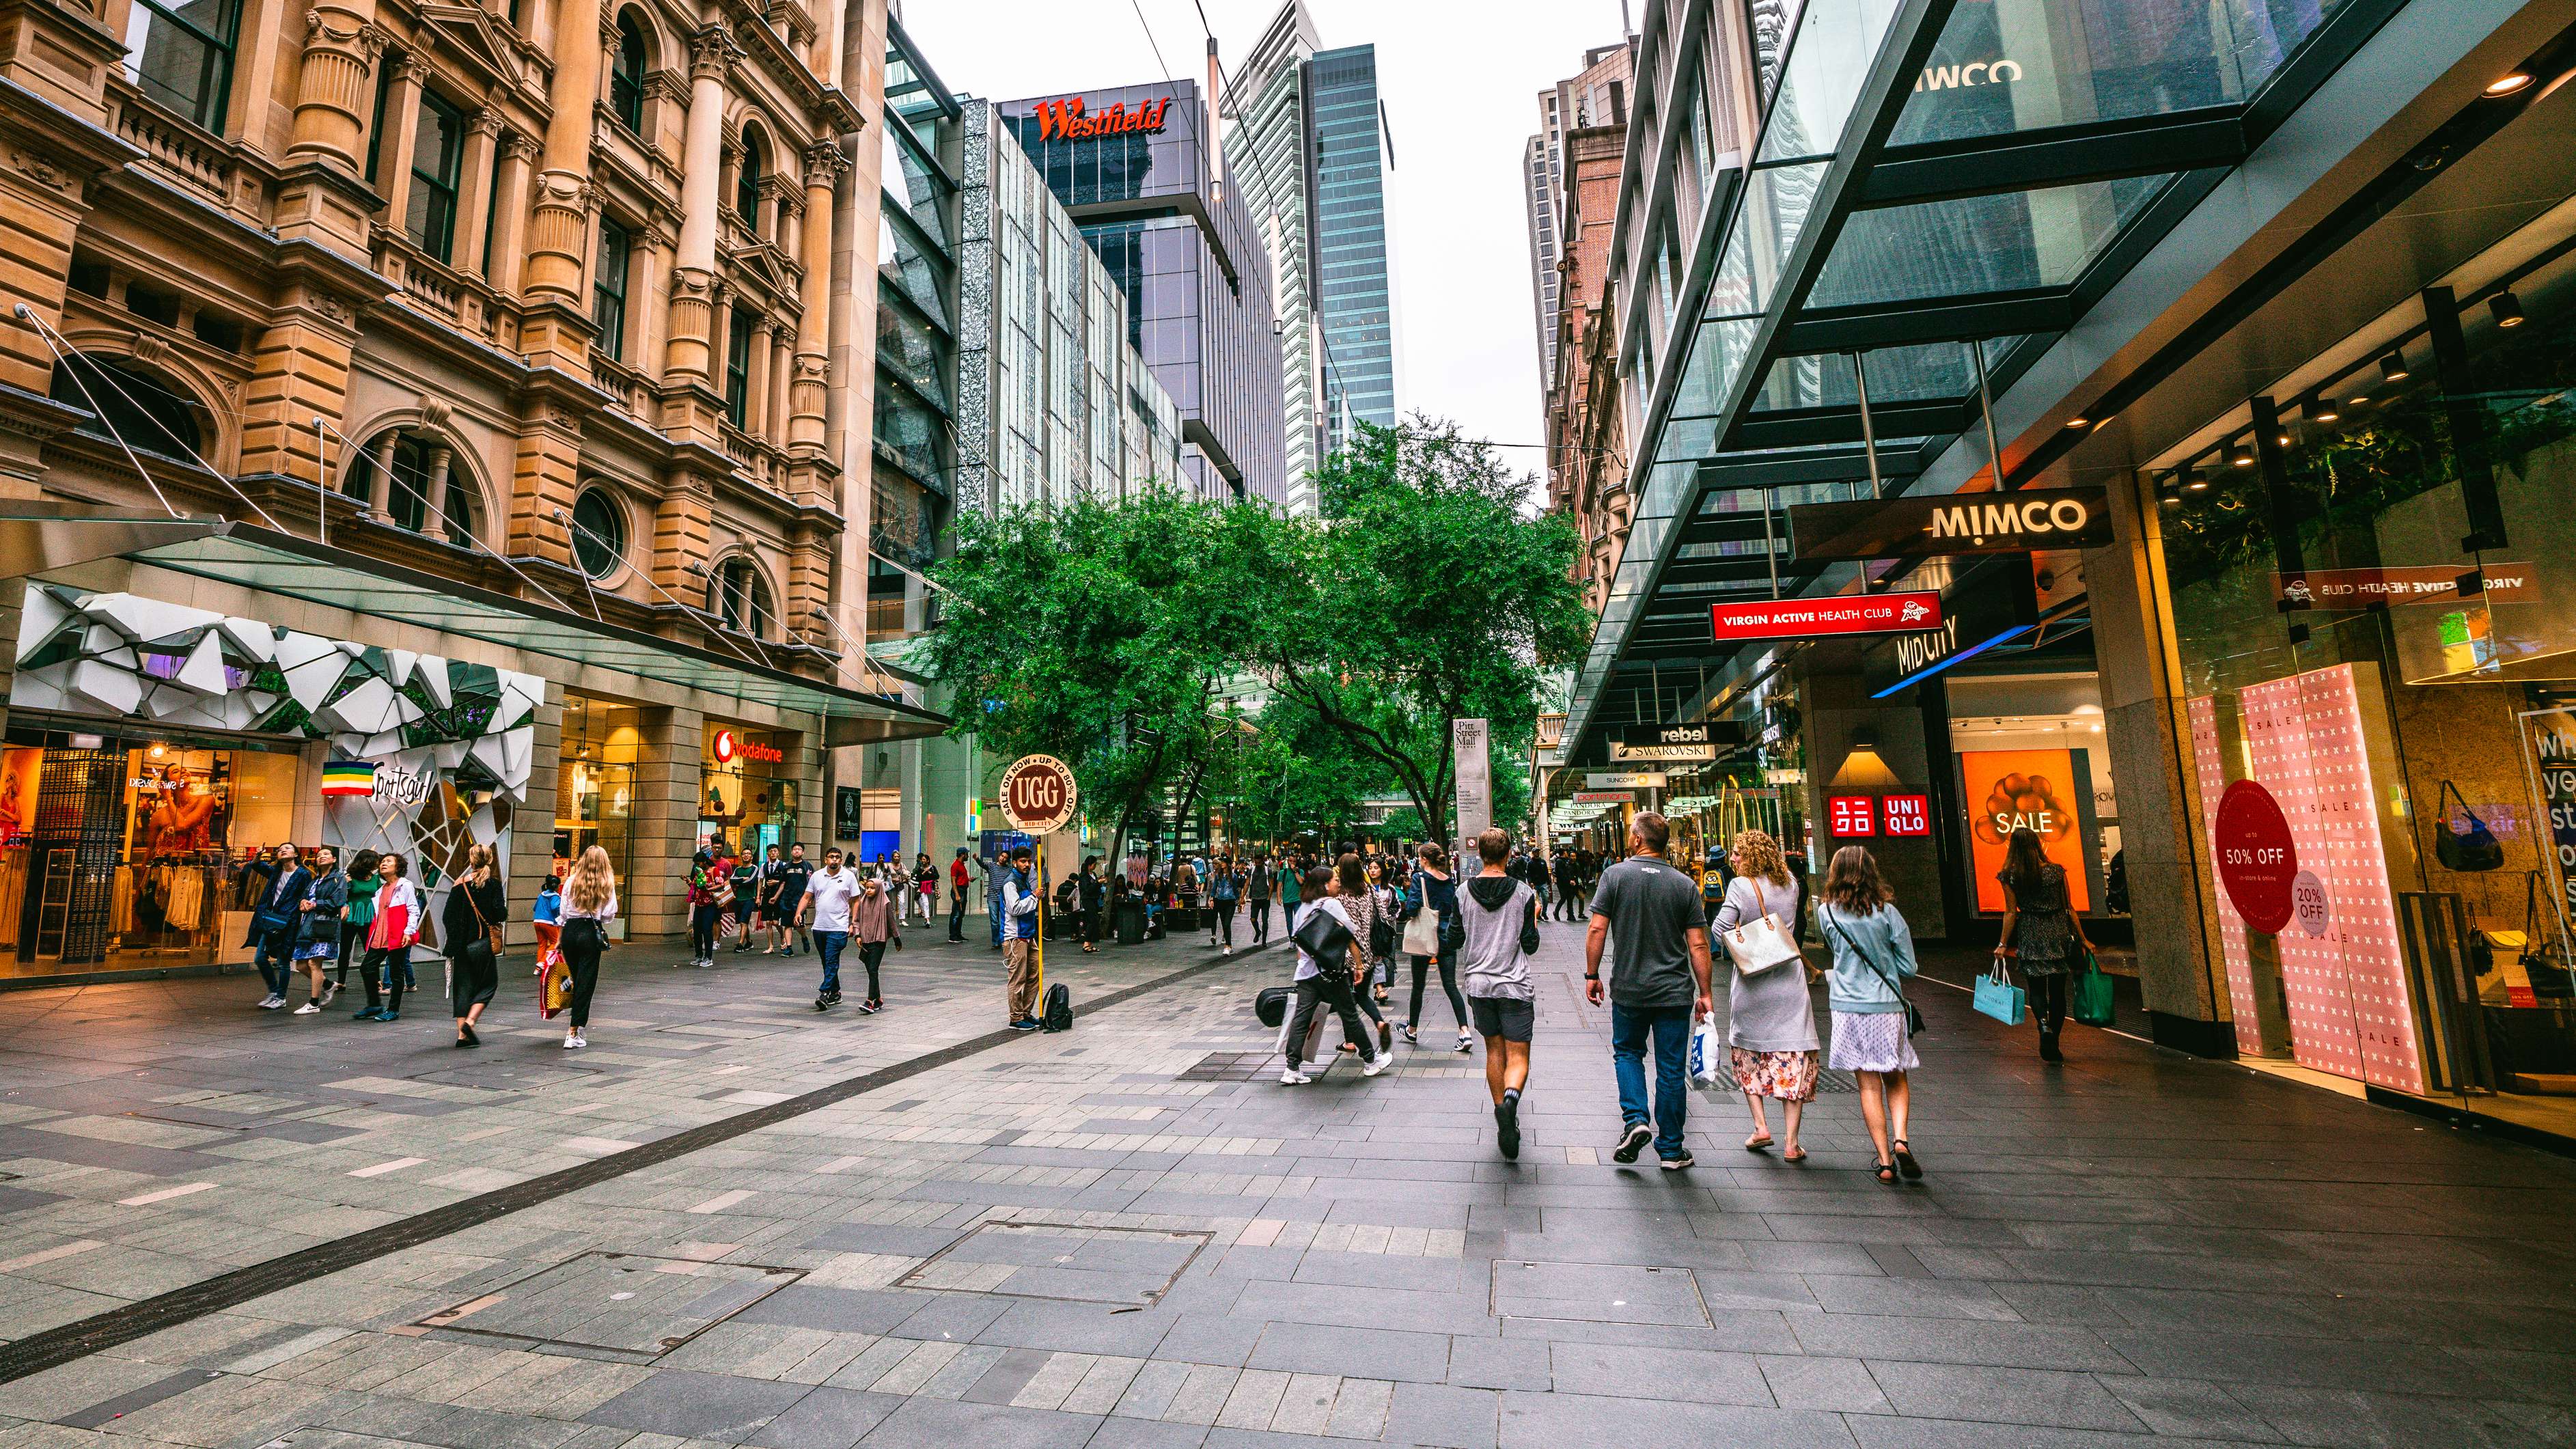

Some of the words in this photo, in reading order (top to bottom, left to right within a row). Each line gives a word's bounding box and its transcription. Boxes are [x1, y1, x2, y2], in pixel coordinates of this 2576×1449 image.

[1032, 96, 1171, 142] Westfield
[1932, 499, 2087, 545] MIMCO
[1723, 615, 1768, 626] VIRGIN
[1773, 612, 1814, 624] ACTIVE
[1818, 609, 1860, 621] HEALTH
[1864, 607, 1892, 618] CLUB
[1458, 721, 1474, 730] Pitt
[2257, 716, 2291, 730] SALE
[1456, 728, 1481, 736] Street
[1456, 736, 1476, 745] Mall
[1661, 726, 1708, 743] rebel
[734, 741, 782, 763] vodafone
[1635, 745, 1706, 756] SWAROVSKI
[1011, 758, 1030, 773] NOW
[1054, 762, 1064, 773] TO
[76, 761, 84, 791] CELEBRATE
[1003, 774, 1013, 788] ON
[1064, 774, 1075, 795] 80%
[1016, 775, 1059, 809] UGG
[1001, 791, 1012, 815] SALE
[1064, 797, 1074, 816] OFF
[1887, 800, 1920, 814] UNI
[2311, 801, 2350, 814] SALE
[1889, 816, 1924, 833] QLO
[1996, 812, 2053, 833] SALE
[2226, 848, 2252, 865] 50%
[2258, 848, 2284, 864] OFF
[2297, 888, 2321, 902] 20%
[2300, 904, 2323, 919] OFF
